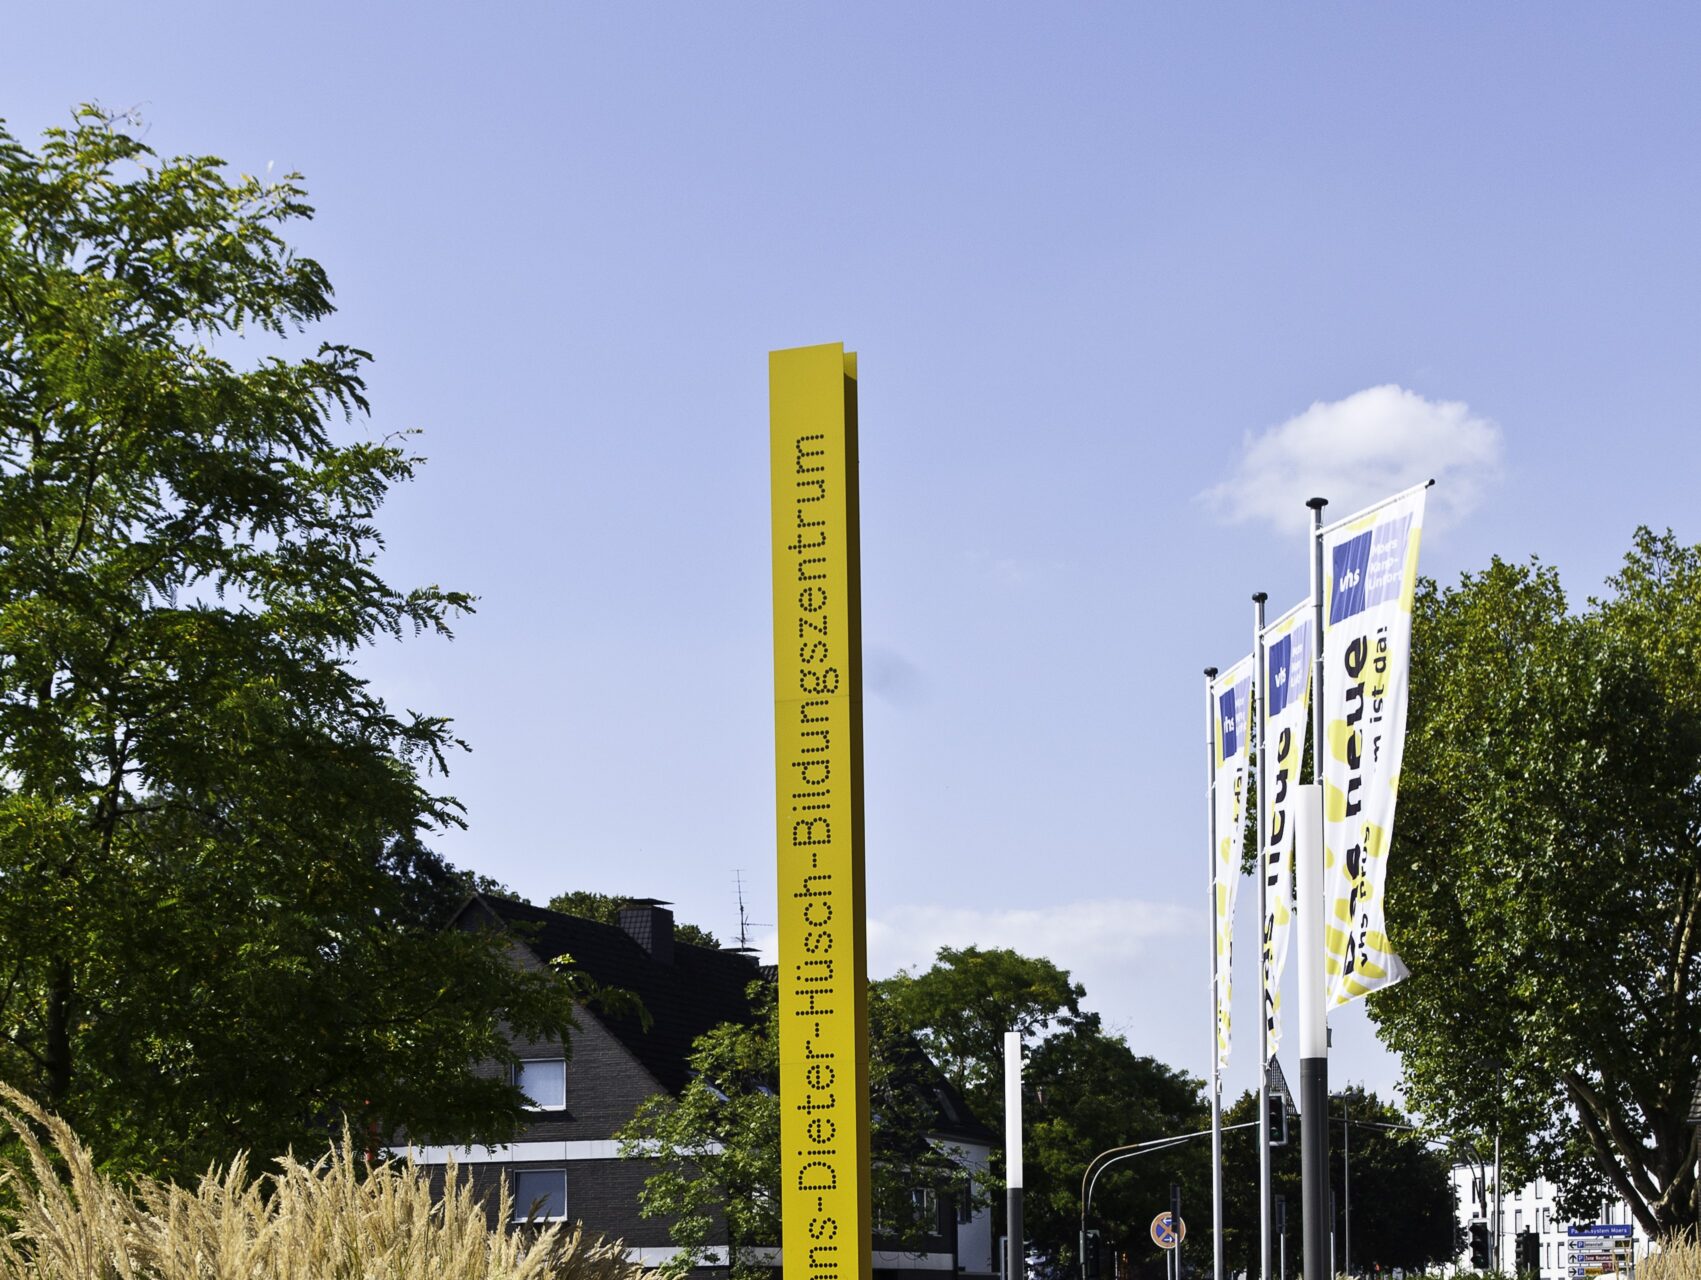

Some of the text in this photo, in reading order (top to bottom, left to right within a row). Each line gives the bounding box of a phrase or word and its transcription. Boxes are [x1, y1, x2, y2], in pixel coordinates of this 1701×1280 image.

[1340, 568, 1360, 593] vhs
[1373, 625, 1388, 674] da!
[1344, 634, 1368, 818] neue
[1370, 684, 1385, 724] ist
